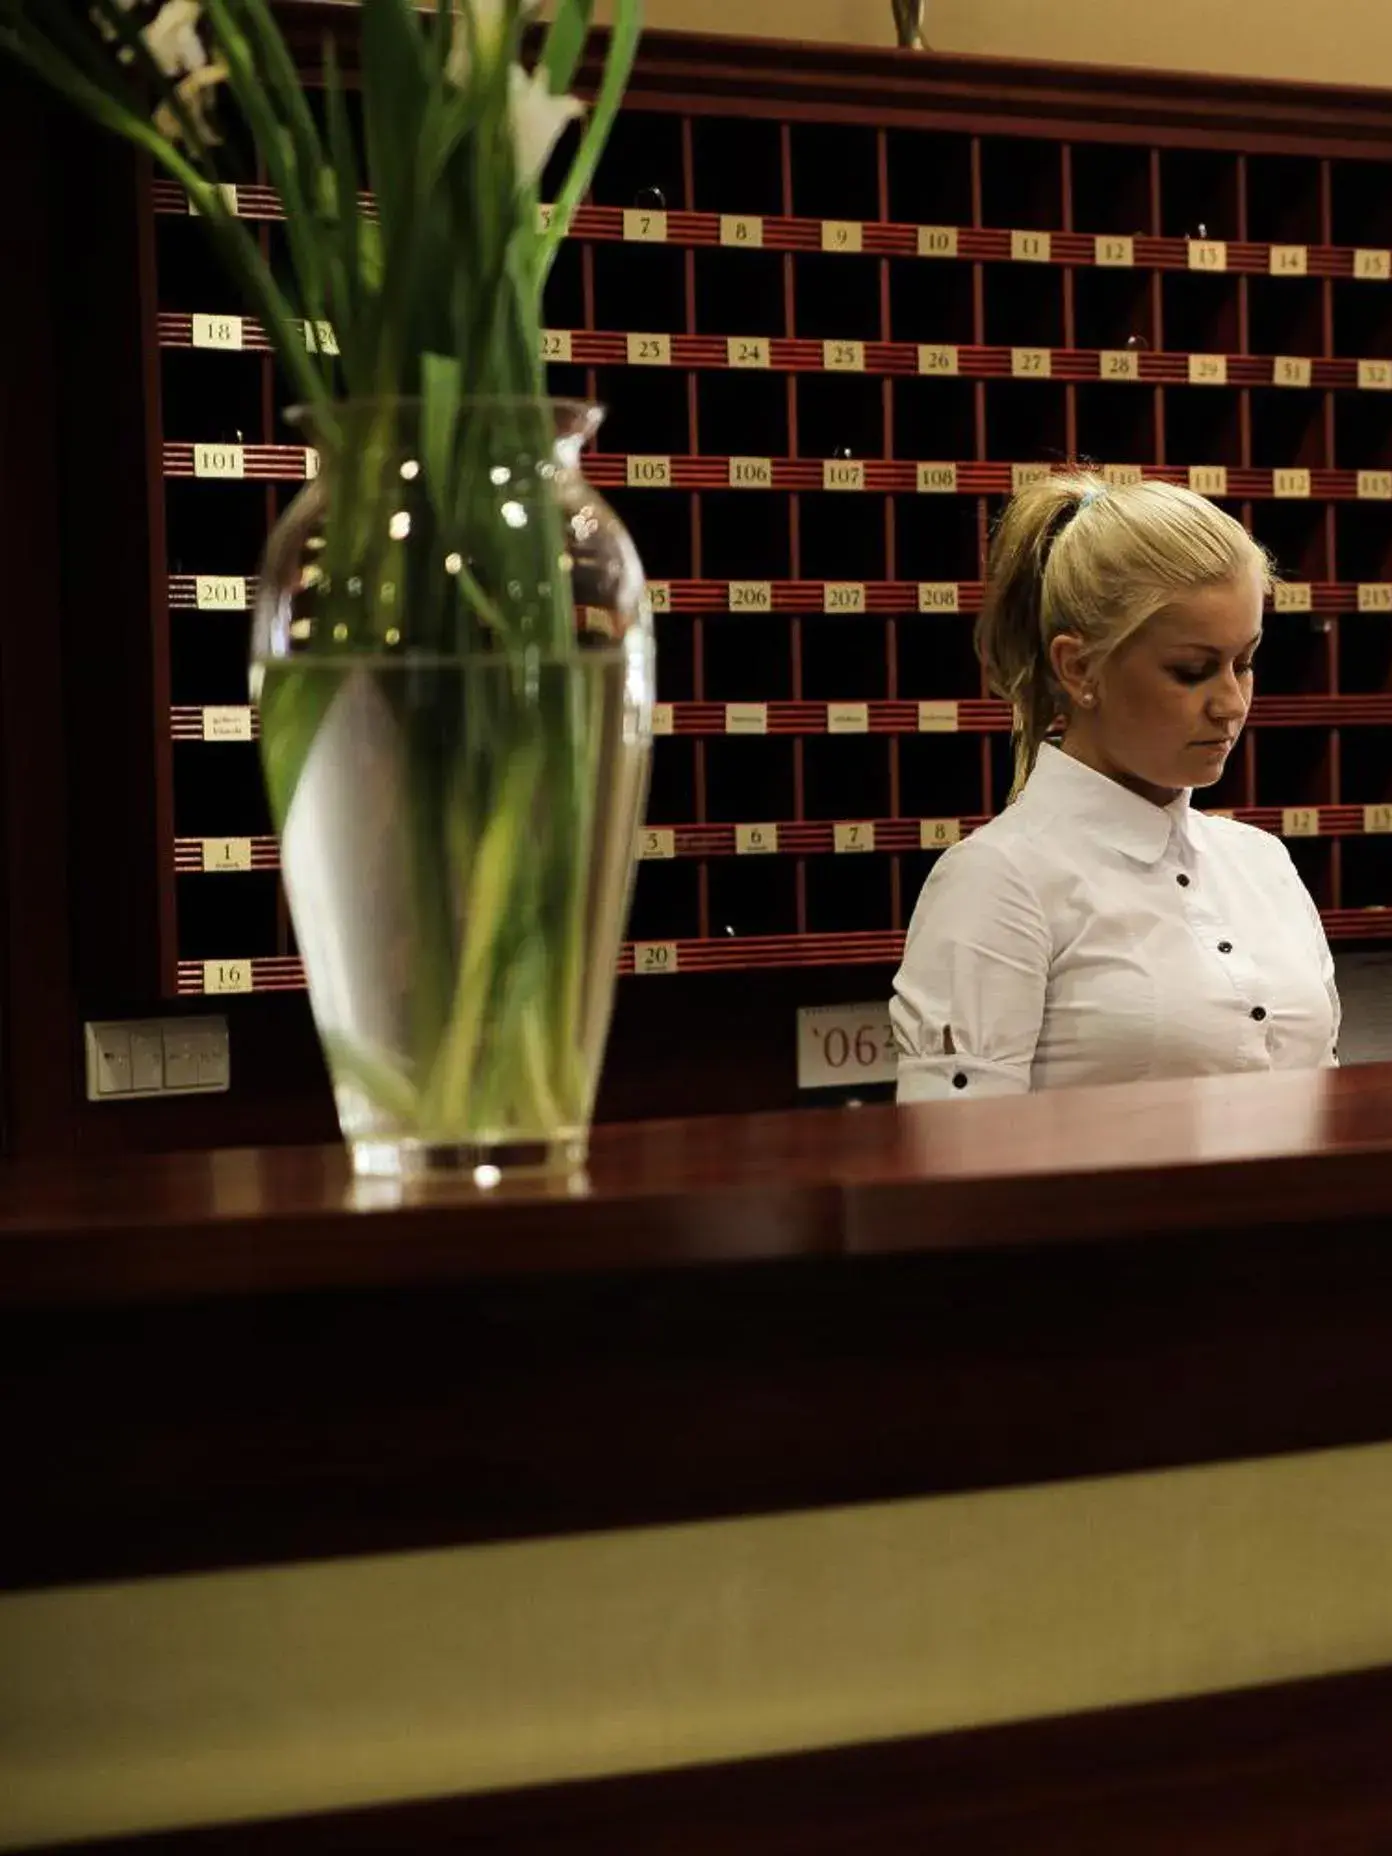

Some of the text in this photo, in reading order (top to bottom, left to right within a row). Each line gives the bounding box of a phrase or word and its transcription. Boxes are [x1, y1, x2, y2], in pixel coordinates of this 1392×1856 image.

[640, 217, 650, 234] 7
[736, 223, 747, 240] 8
[837, 229, 847, 246] 9
[930, 234, 949, 249] 10
[1023, 239, 1038, 254] 11
[1106, 243, 1124, 260] 12
[209, 324, 230, 340] 18
[639, 341, 660, 357] 23
[738, 344, 760, 360] 24
[834, 346, 855, 363] 25
[928, 352, 949, 368] 26
[1021, 354, 1041, 370] 27
[1110, 357, 1130, 374] 28
[204, 452, 234, 469] 101
[635, 464, 665, 480] 105
[737, 464, 767, 481] 106
[831, 467, 859, 483] 107
[924, 470, 953, 486] 108
[204, 585, 236, 600] 201
[733, 589, 767, 605] 206
[829, 589, 860, 607] 207
[923, 590, 954, 606] 208
[1293, 812, 1310, 828] 12
[751, 828, 762, 844] 6
[848, 827, 859, 842] 7
[935, 824, 946, 839] 8
[648, 833, 657, 849] 5
[225, 844, 230, 860] 1
[645, 947, 668, 964] 20
